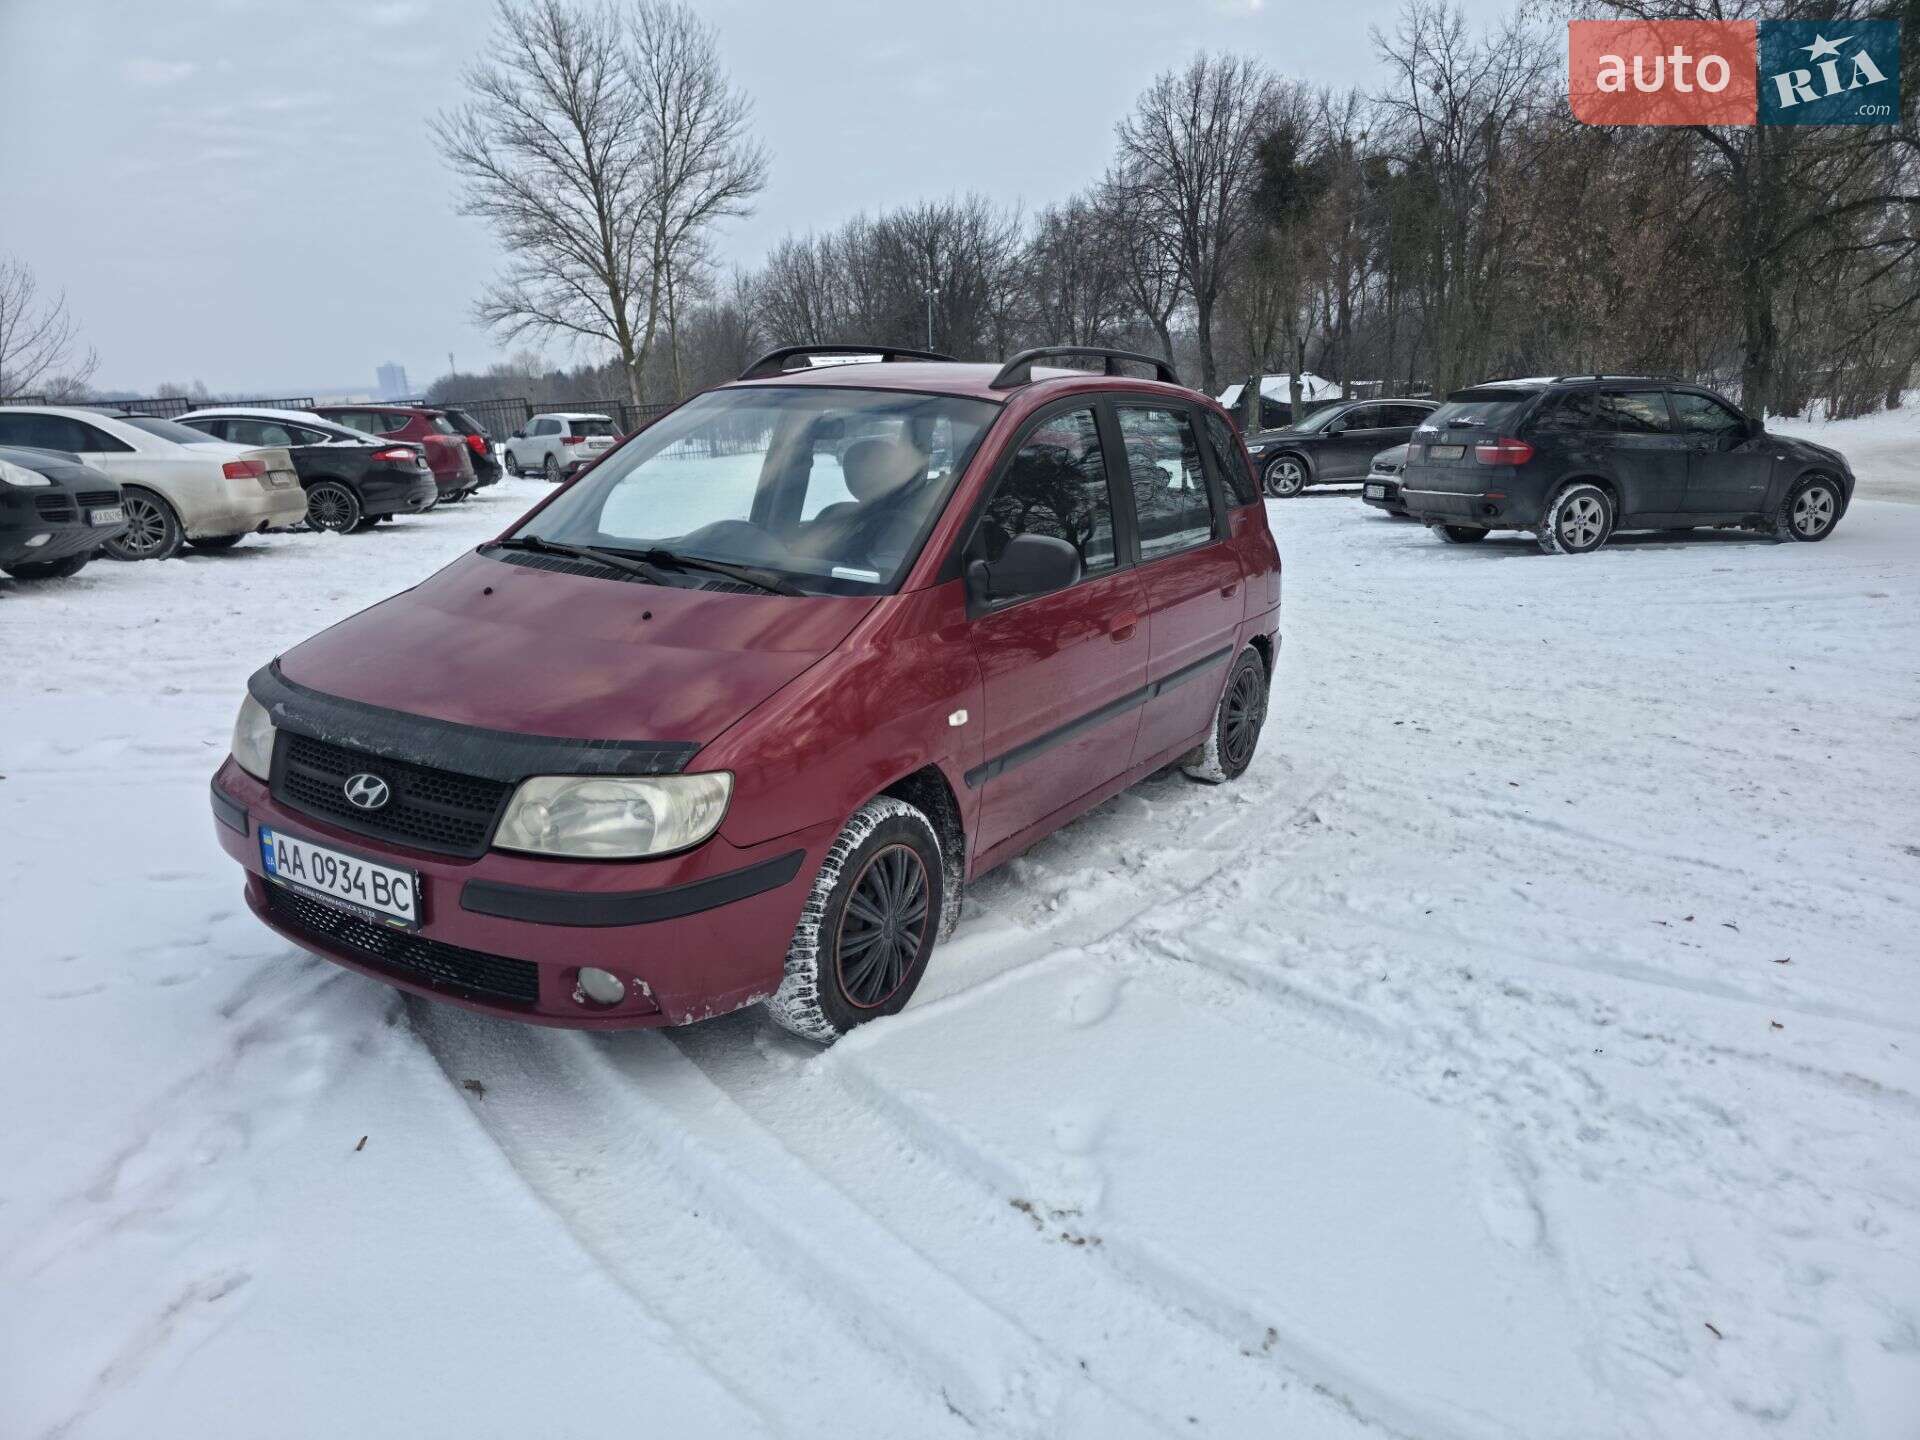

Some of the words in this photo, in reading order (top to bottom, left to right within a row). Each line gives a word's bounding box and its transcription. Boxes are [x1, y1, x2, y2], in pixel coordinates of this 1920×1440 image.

[278, 839, 306, 879] AA
[311, 852, 367, 900] 0934
[371, 870, 410, 911] BC
